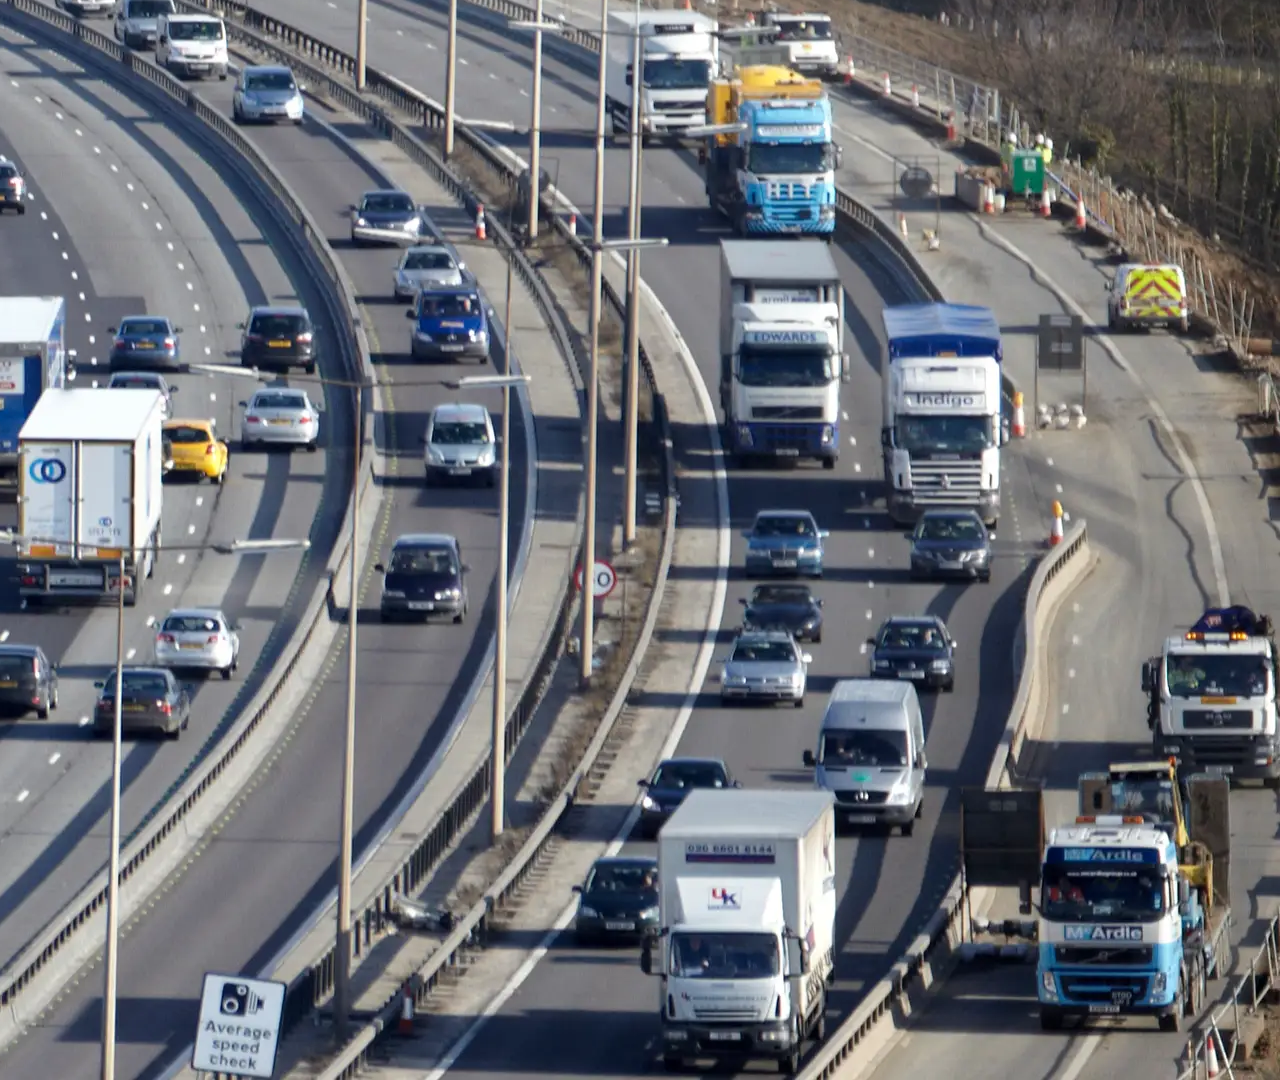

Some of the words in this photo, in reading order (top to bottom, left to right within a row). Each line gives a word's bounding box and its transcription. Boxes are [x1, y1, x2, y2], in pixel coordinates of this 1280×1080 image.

[754, 332, 817, 342] EDWARDS
[917, 392, 974, 408] Indigo
[712, 888, 736, 904] UK
[205, 1020, 271, 1039] Average
[212, 1040, 260, 1054] speed
[210, 1053, 256, 1069] check
